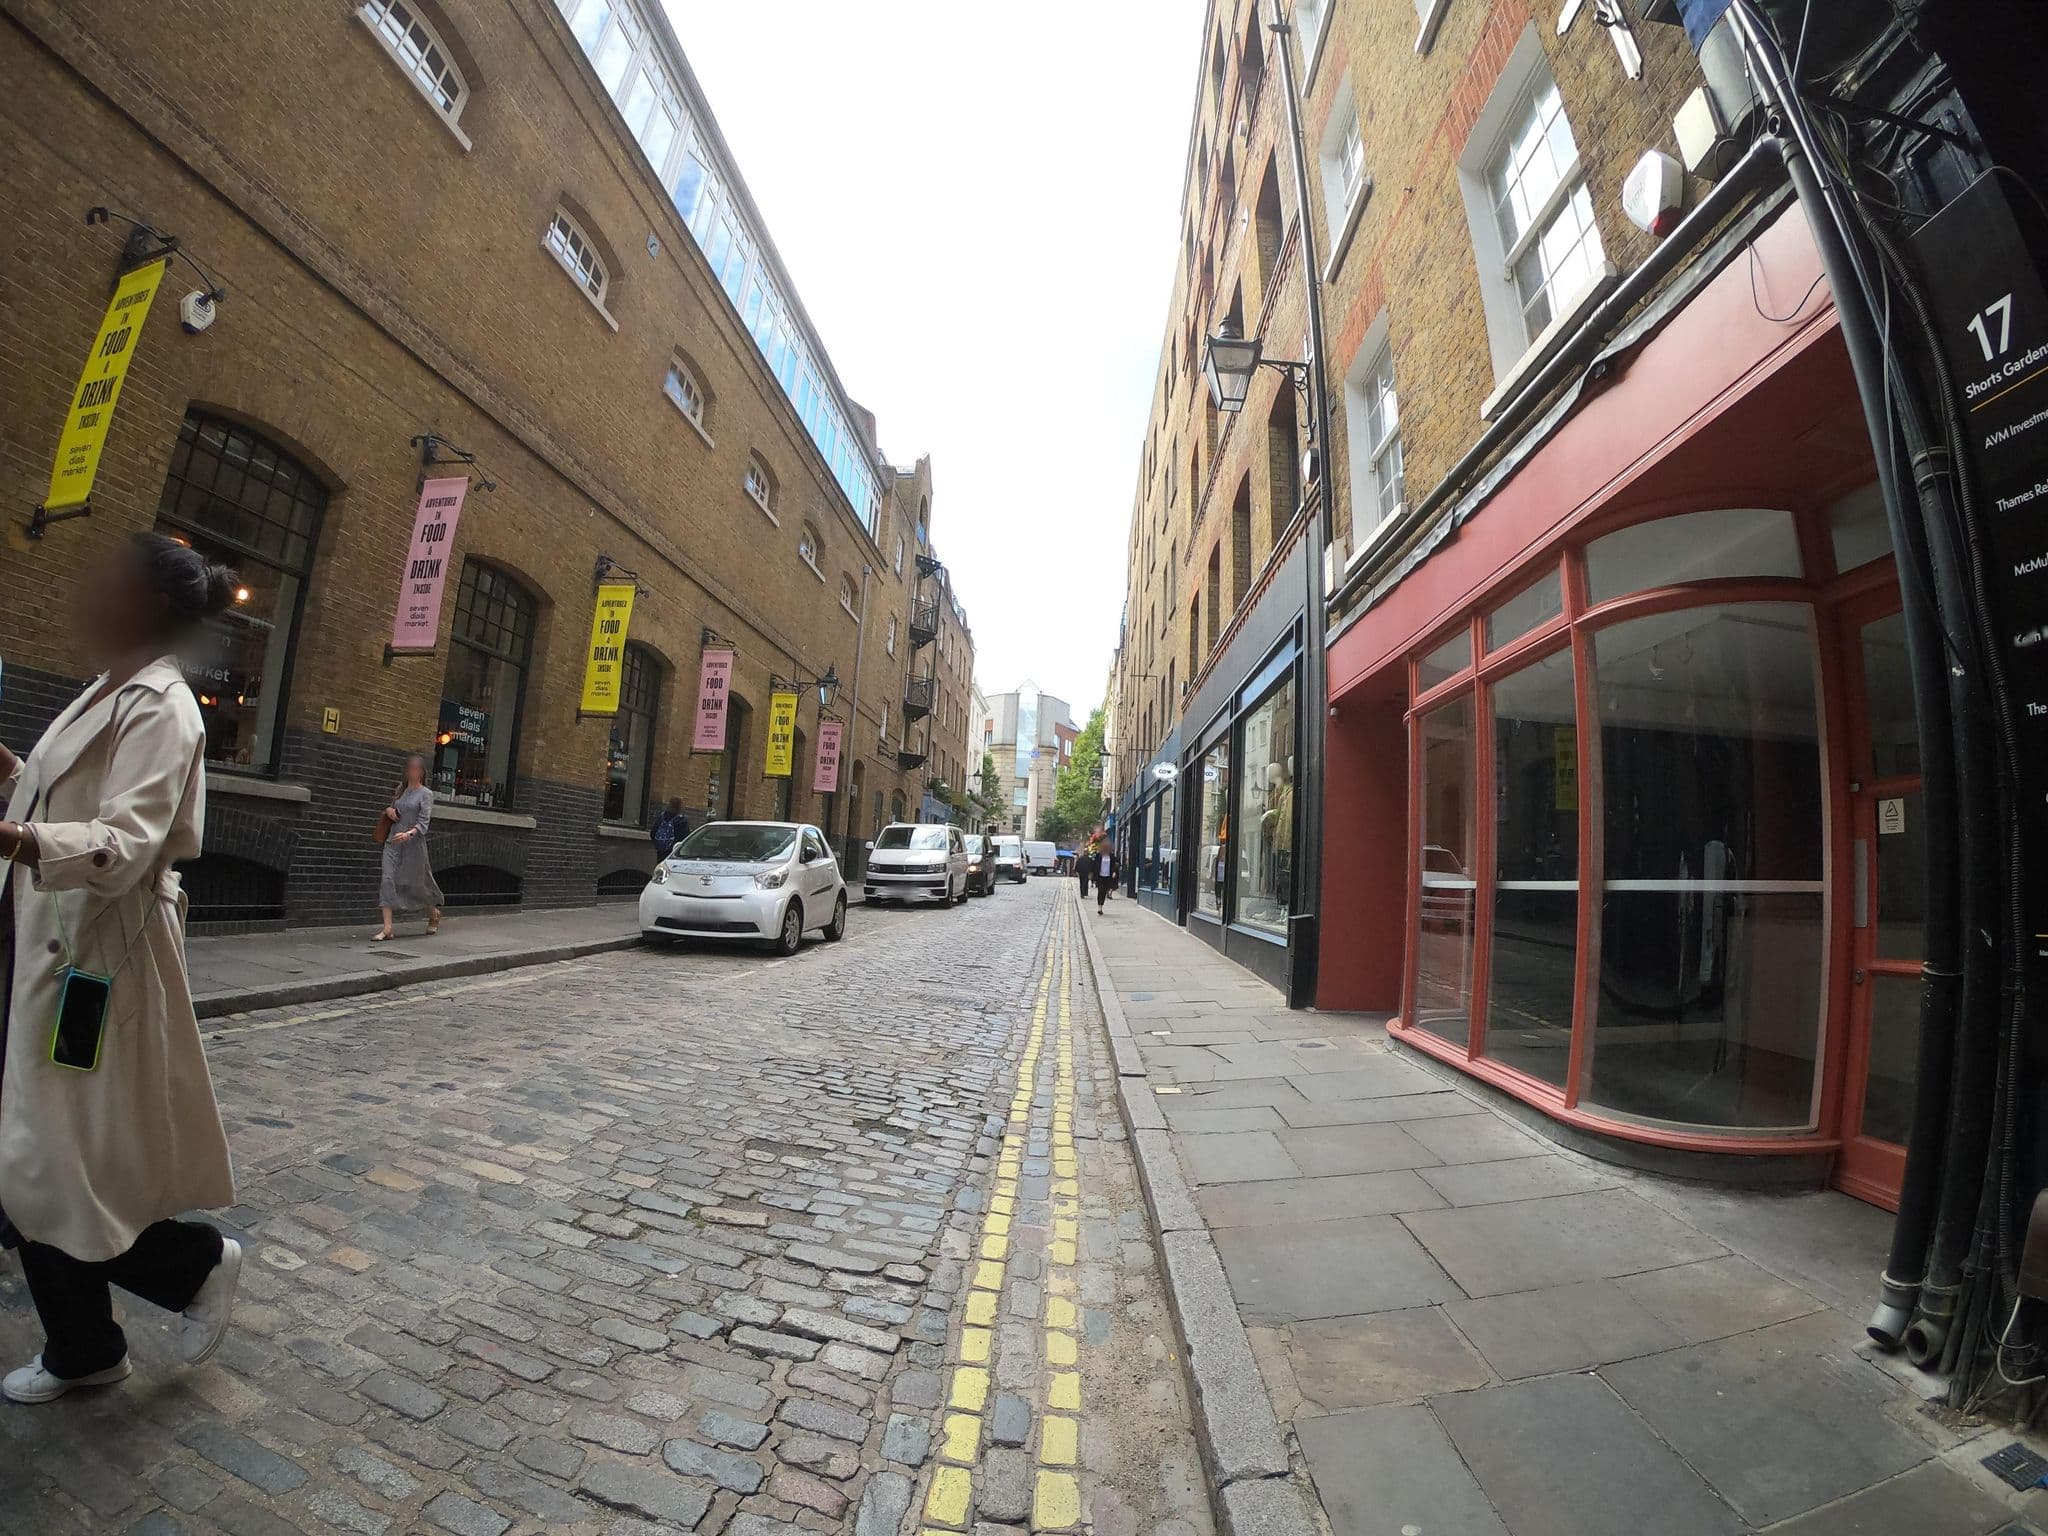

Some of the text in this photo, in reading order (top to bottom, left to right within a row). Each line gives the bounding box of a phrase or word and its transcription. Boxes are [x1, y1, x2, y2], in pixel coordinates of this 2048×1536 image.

[115, 288, 150, 311] ADVENTURES
[121, 312, 128, 325] IN
[1966, 292, 2013, 362] 17
[99, 326, 132, 358] FOOD
[103, 360, 110, 373] &
[78, 376, 118, 409] DRINK
[1965, 371, 2003, 400] Shorts
[77, 412, 101, 430] INSIDE
[1984, 428, 2010, 450] AVM
[69, 444, 92, 455] seven
[68, 454, 86, 465] dials
[61, 465, 88, 477] market
[425, 496, 458, 509] ADVENTURES
[1995, 490, 2035, 512] Thames
[434, 511, 441, 521] IN
[420, 523, 447, 543] FOOD
[427, 545, 433, 556] &
[410, 559, 442, 579] DRINK
[413, 583, 432, 595] INSIDE
[409, 605, 429, 613] seven
[409, 612, 426, 620] dials
[404, 620, 430, 628] market
[600, 620, 620, 634] FOOD
[593, 647, 619, 661] DRINK
[182, 663, 231, 682] arket
[705, 677, 724, 689] FOOD
[702, 698, 723, 711] DRINK
[2026, 702, 2048, 716] The
[326, 709, 338, 731] H
[458, 705, 485, 721] seven
[460, 719, 481, 732] dials
[452, 731, 485, 747] market
